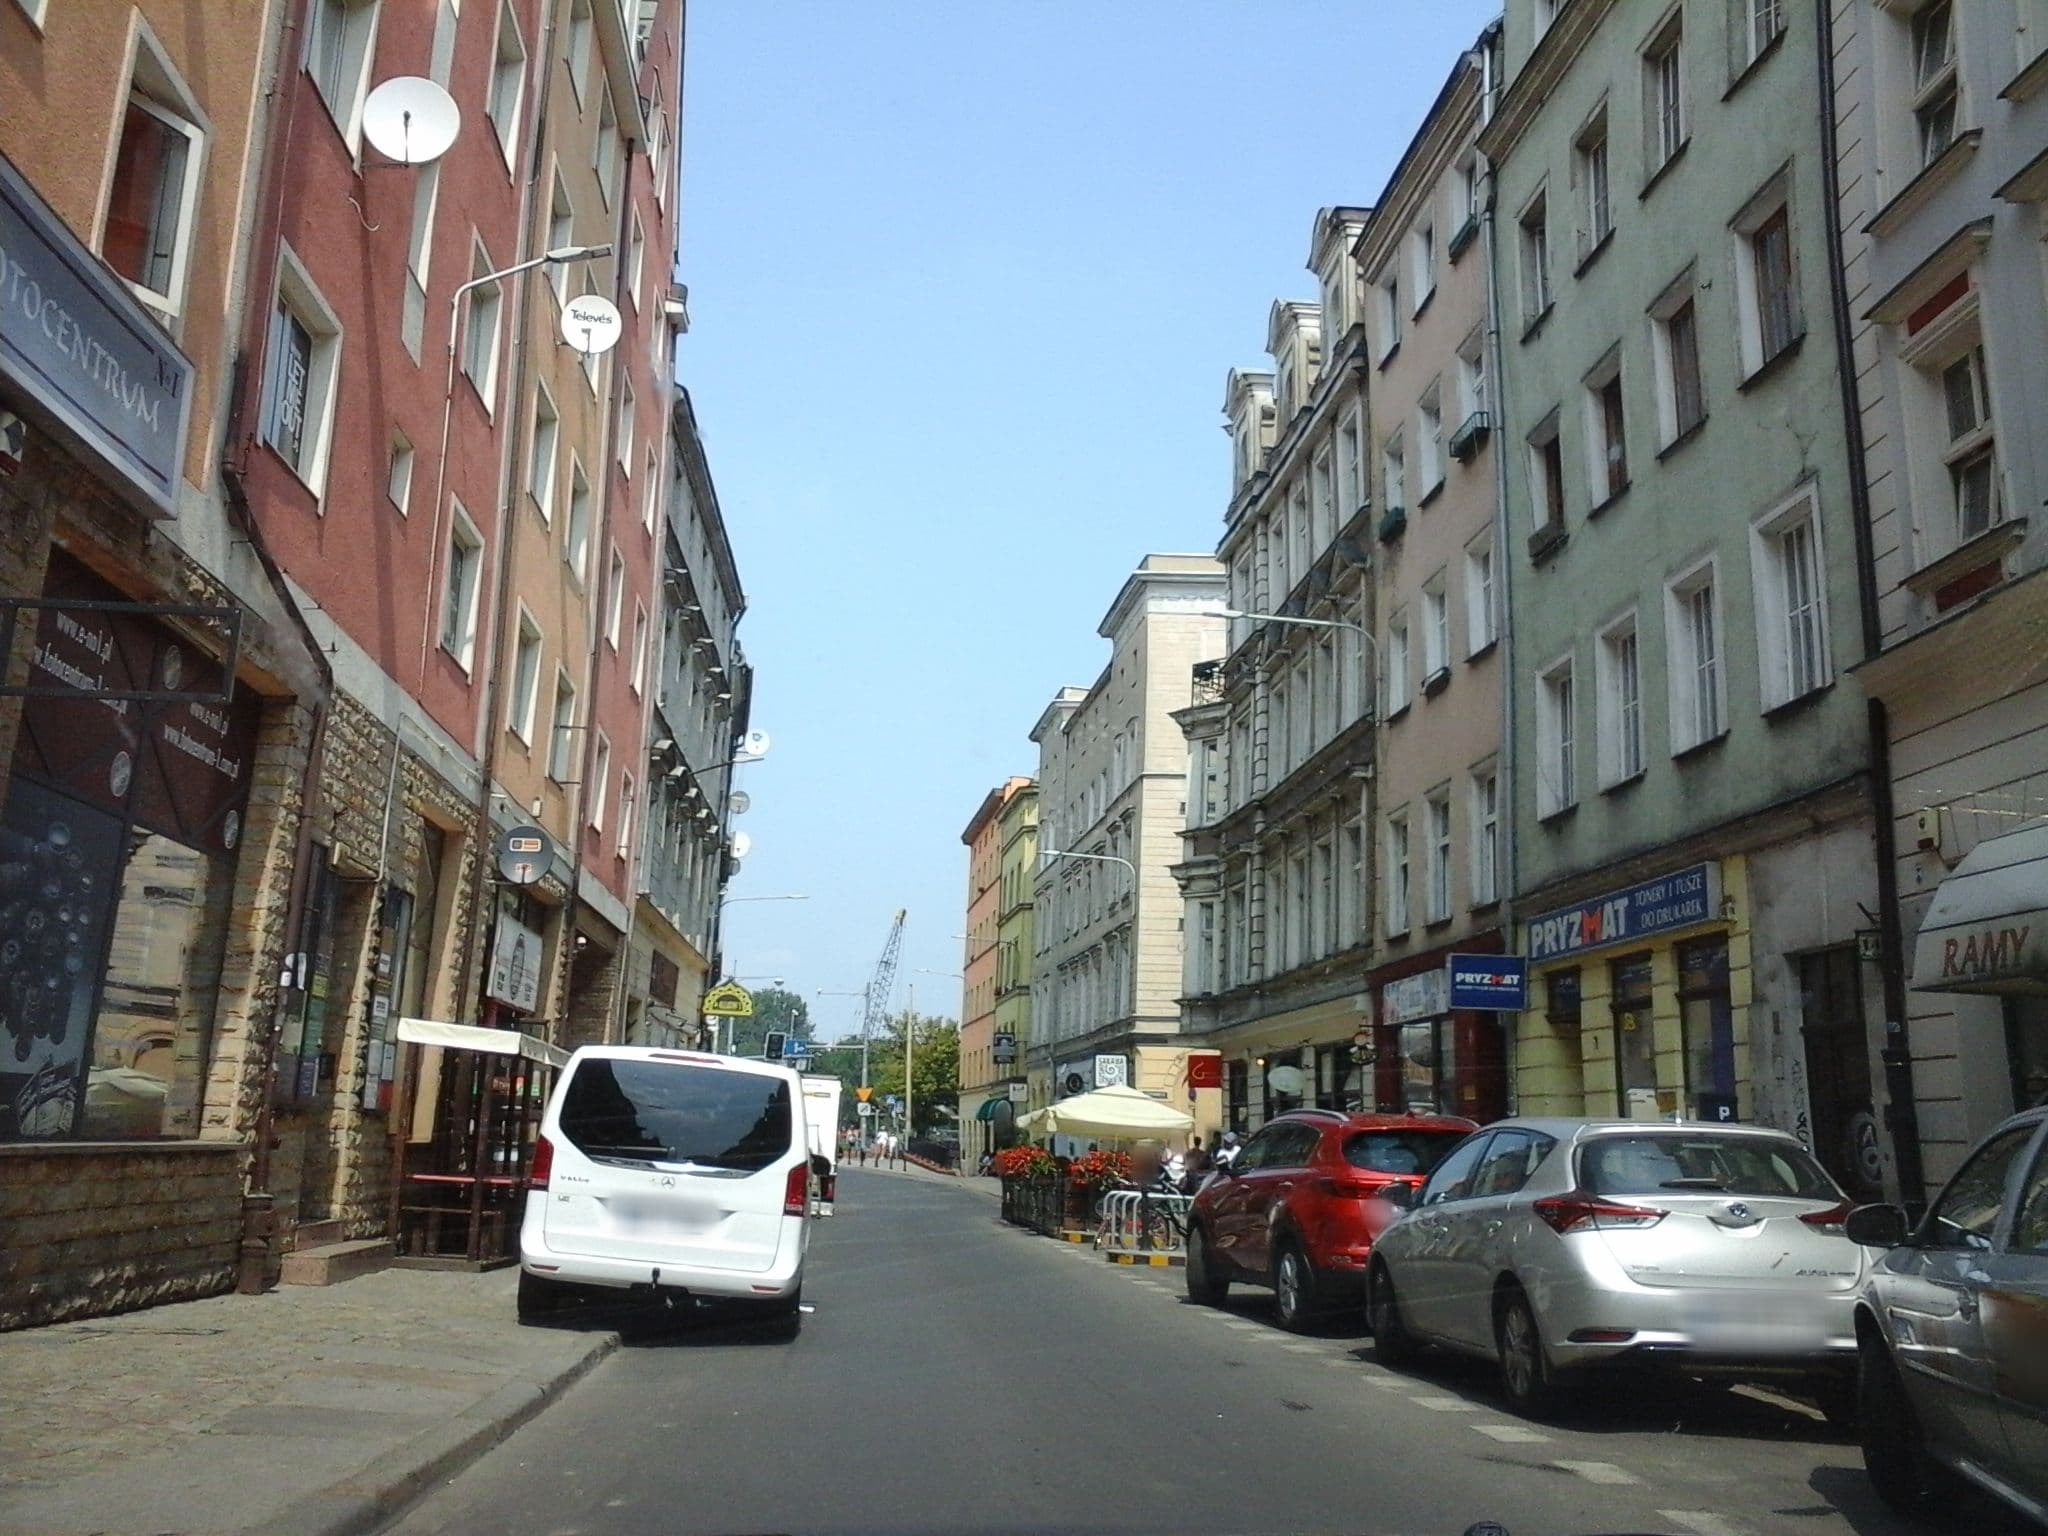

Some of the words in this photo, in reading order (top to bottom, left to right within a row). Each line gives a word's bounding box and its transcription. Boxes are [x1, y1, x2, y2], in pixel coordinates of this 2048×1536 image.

[571, 308, 613, 325] Televés
[1635, 884, 1667, 907] TONERY
[1676, 872, 1703, 895] TUSZE
[1530, 897, 1630, 959] PRYZMAT
[1640, 909, 1656, 929] DO
[1656, 897, 1703, 926] DRUKAREK
[1941, 925, 2031, 978] RAMY
[1455, 972, 1520, 985] PRYZMAT
